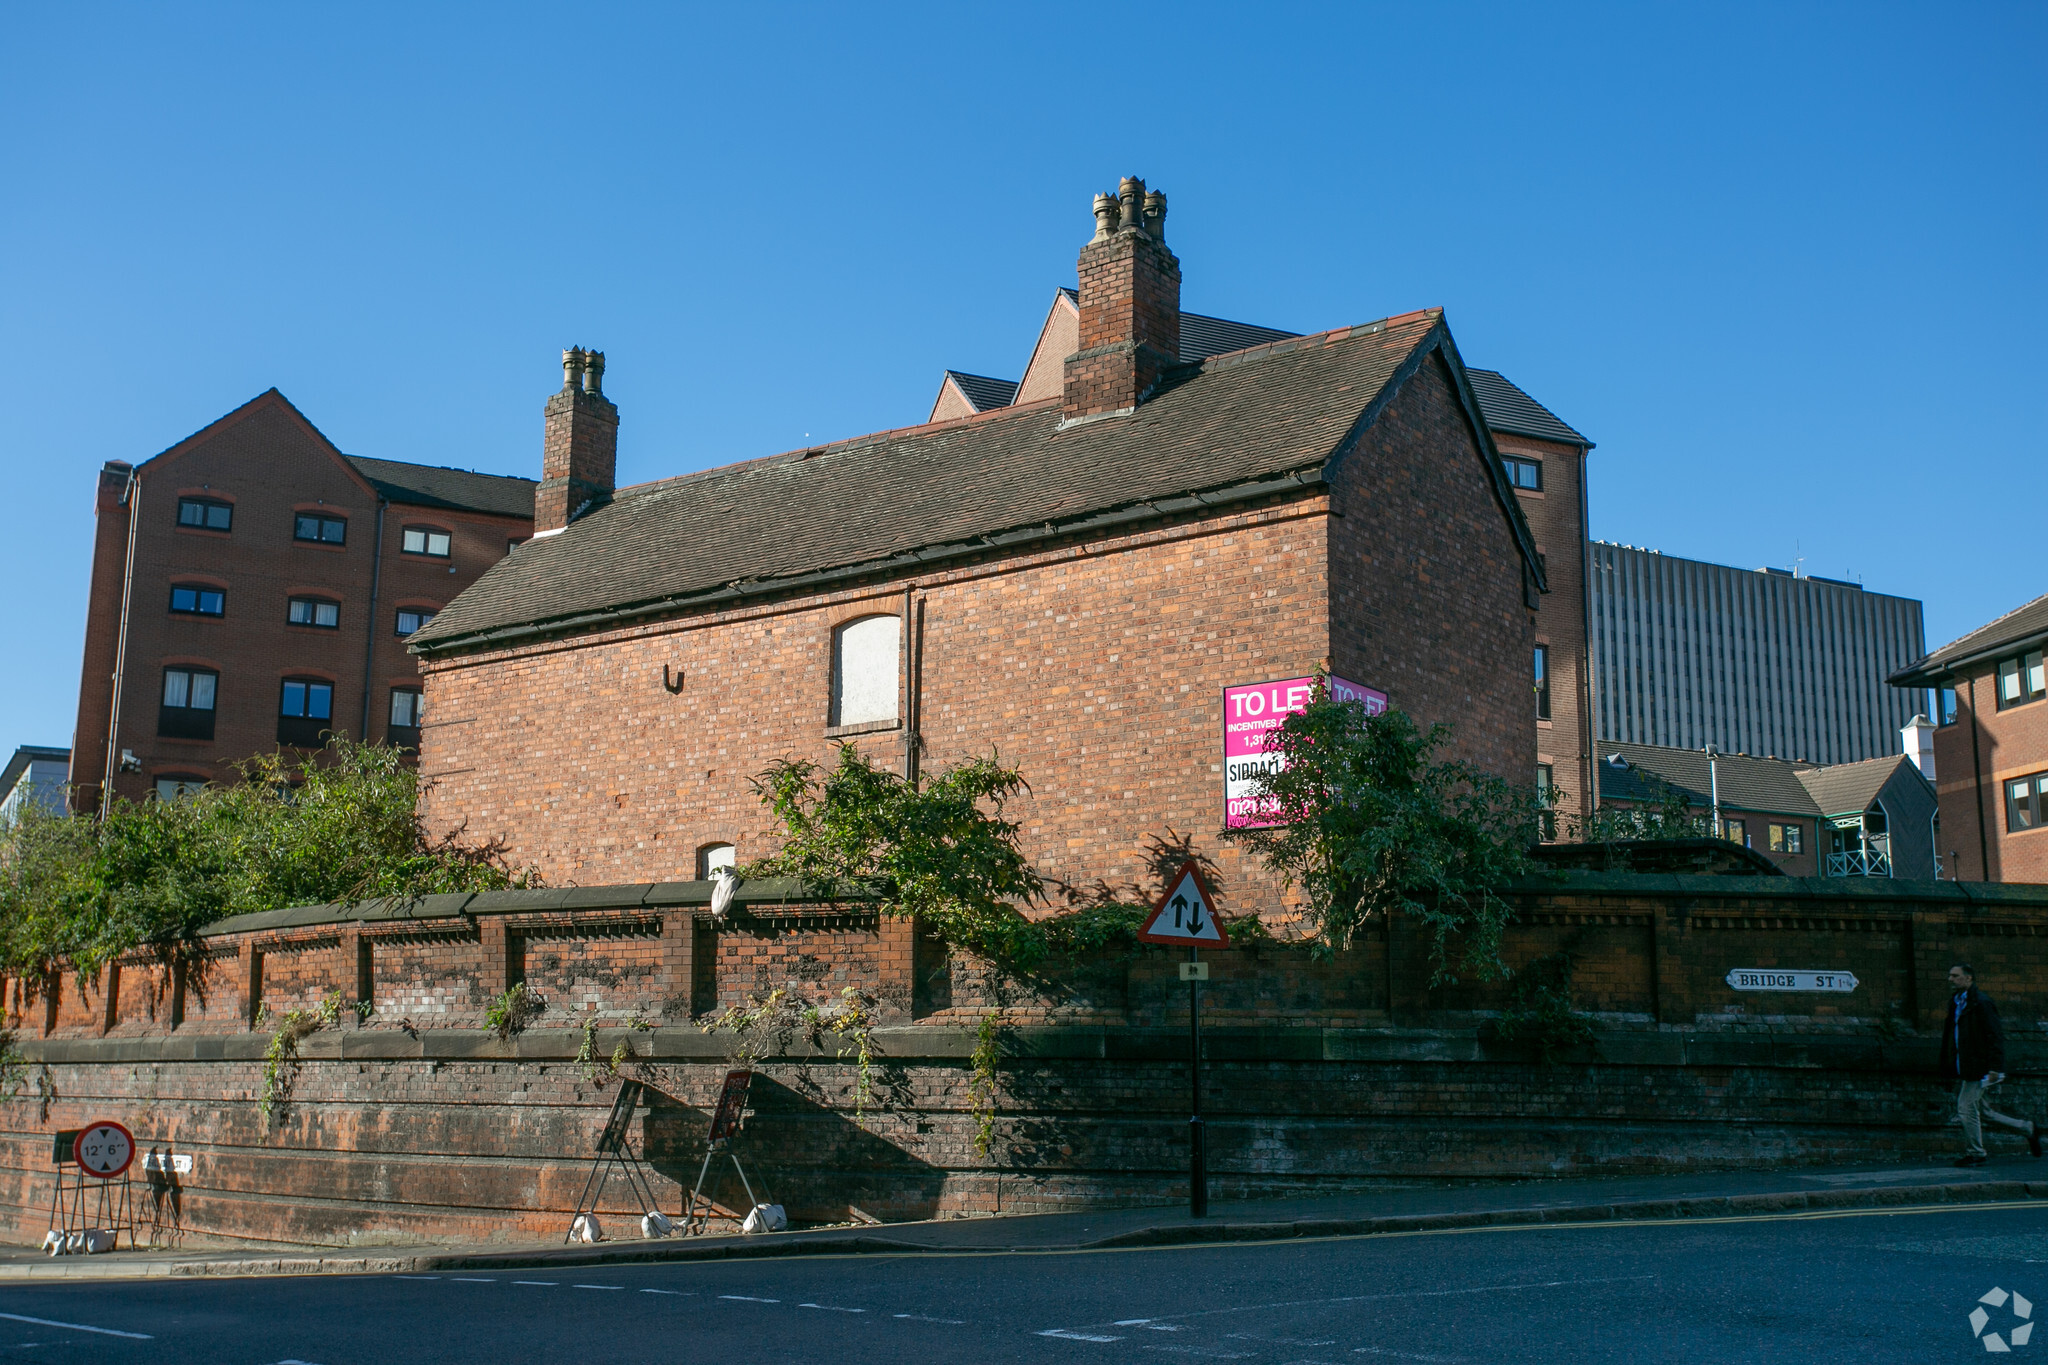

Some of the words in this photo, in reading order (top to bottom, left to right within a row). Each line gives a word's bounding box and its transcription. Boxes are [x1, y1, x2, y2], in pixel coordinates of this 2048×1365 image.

[1334, 684, 1355, 703] TO
[1230, 691, 1266, 718] TO
[1228, 718, 1277, 733] INCENTIVES
[1243, 734, 1268, 748] 1,31
[1228, 799, 1257, 816] 0121
[1740, 974, 1796, 987] BRIDGE
[1815, 976, 1835, 987] ST
